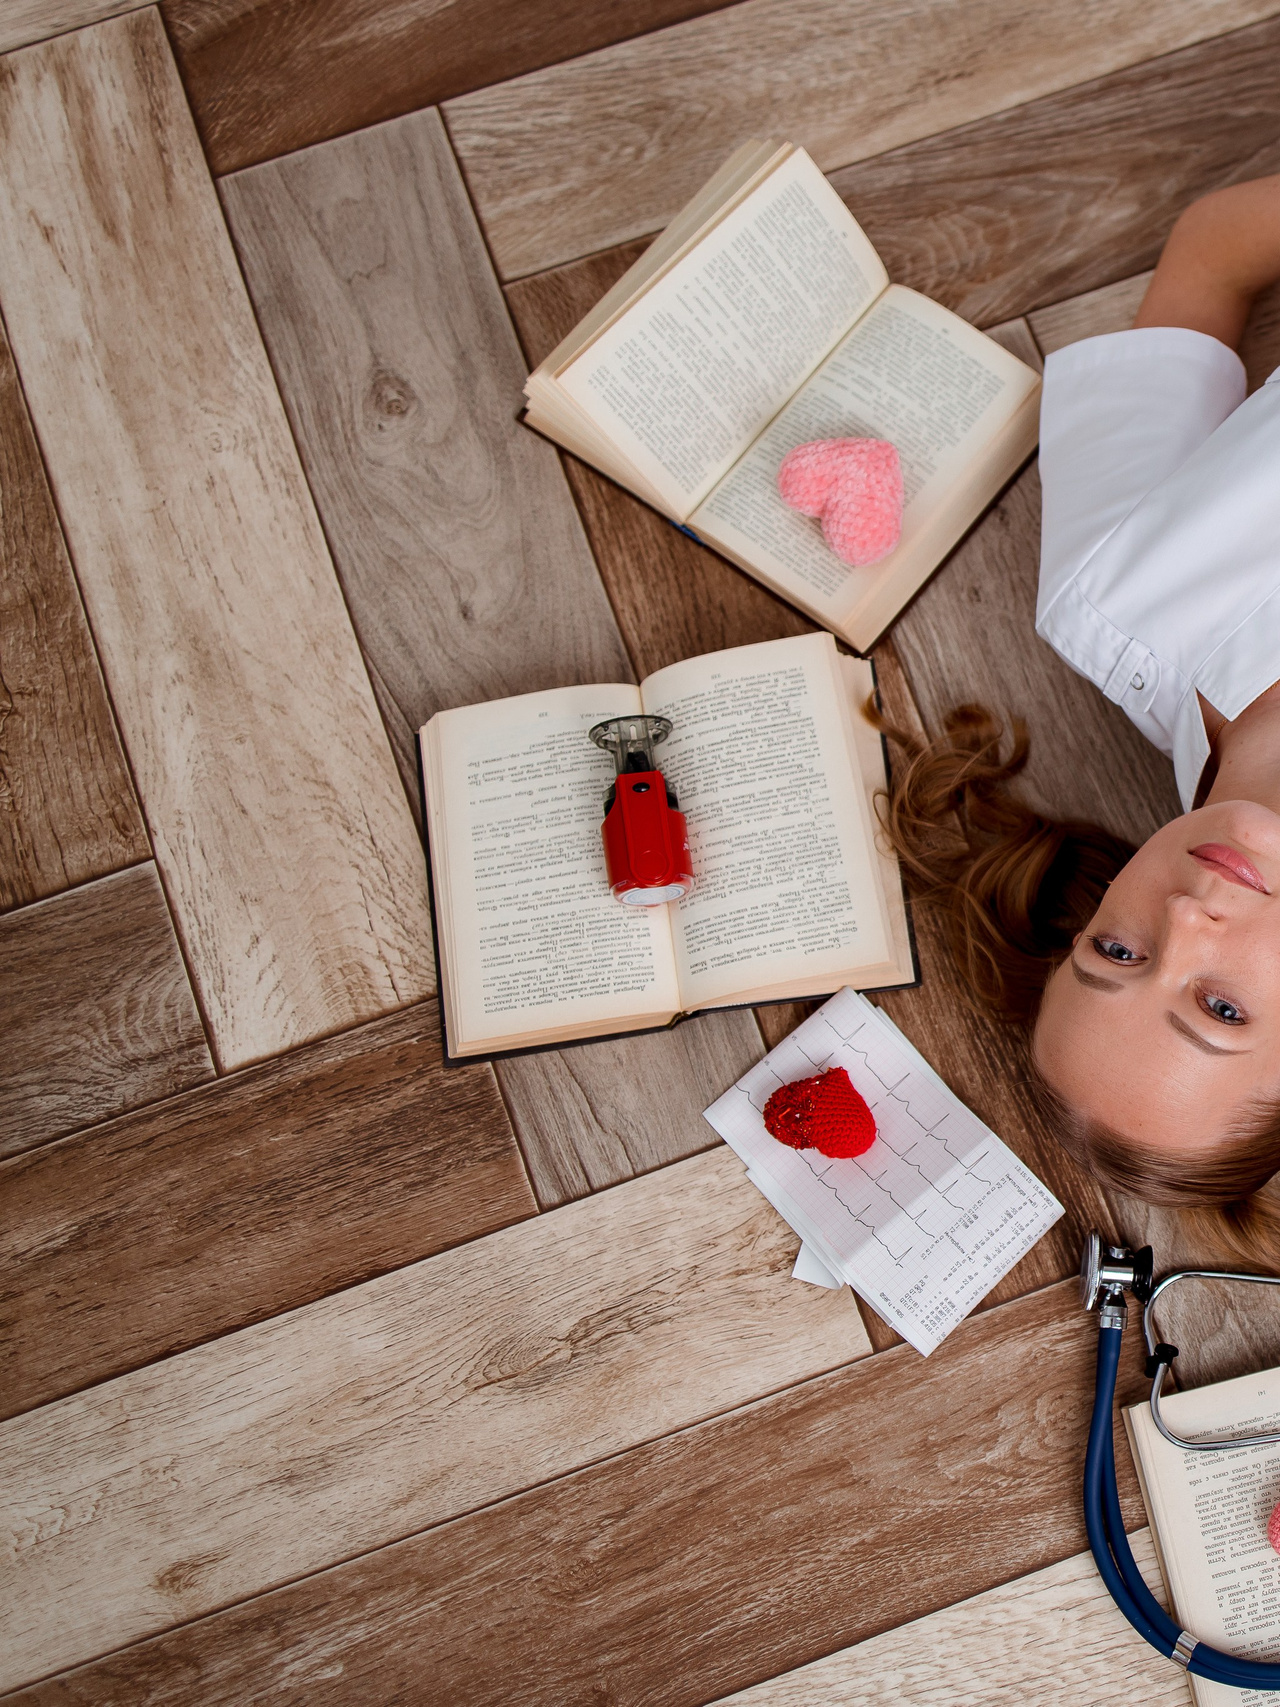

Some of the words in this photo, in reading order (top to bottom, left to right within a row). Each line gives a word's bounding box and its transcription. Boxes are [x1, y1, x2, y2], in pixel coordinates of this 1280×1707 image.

[1014, 1164, 1032, 1184] 13:15:15
[1248, 1620, 1275, 1631] спросила
[1225, 1628, 1246, 1636] Хетти.
